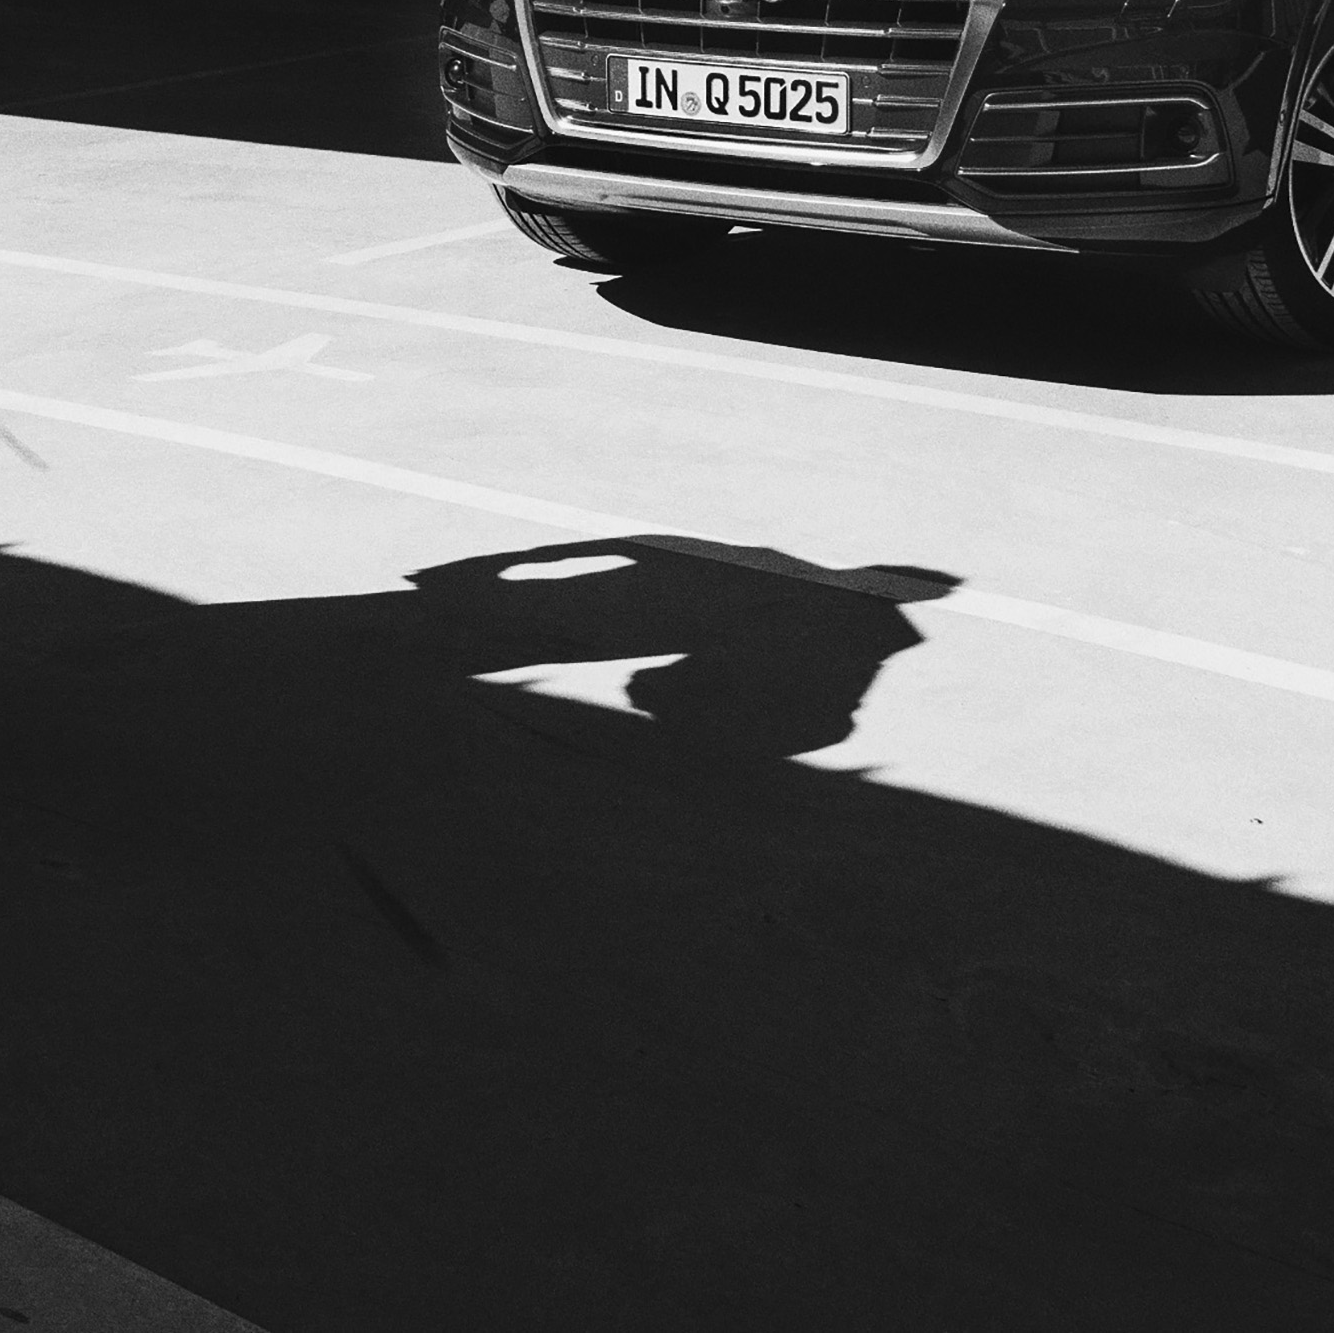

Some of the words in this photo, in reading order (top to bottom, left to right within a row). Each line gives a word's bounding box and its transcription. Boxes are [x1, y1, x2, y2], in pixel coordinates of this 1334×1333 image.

[614, 90, 624, 103] D
[635, 66, 679, 111] IN
[706, 72, 730, 116] Q
[738, 74, 840, 124] 5025
